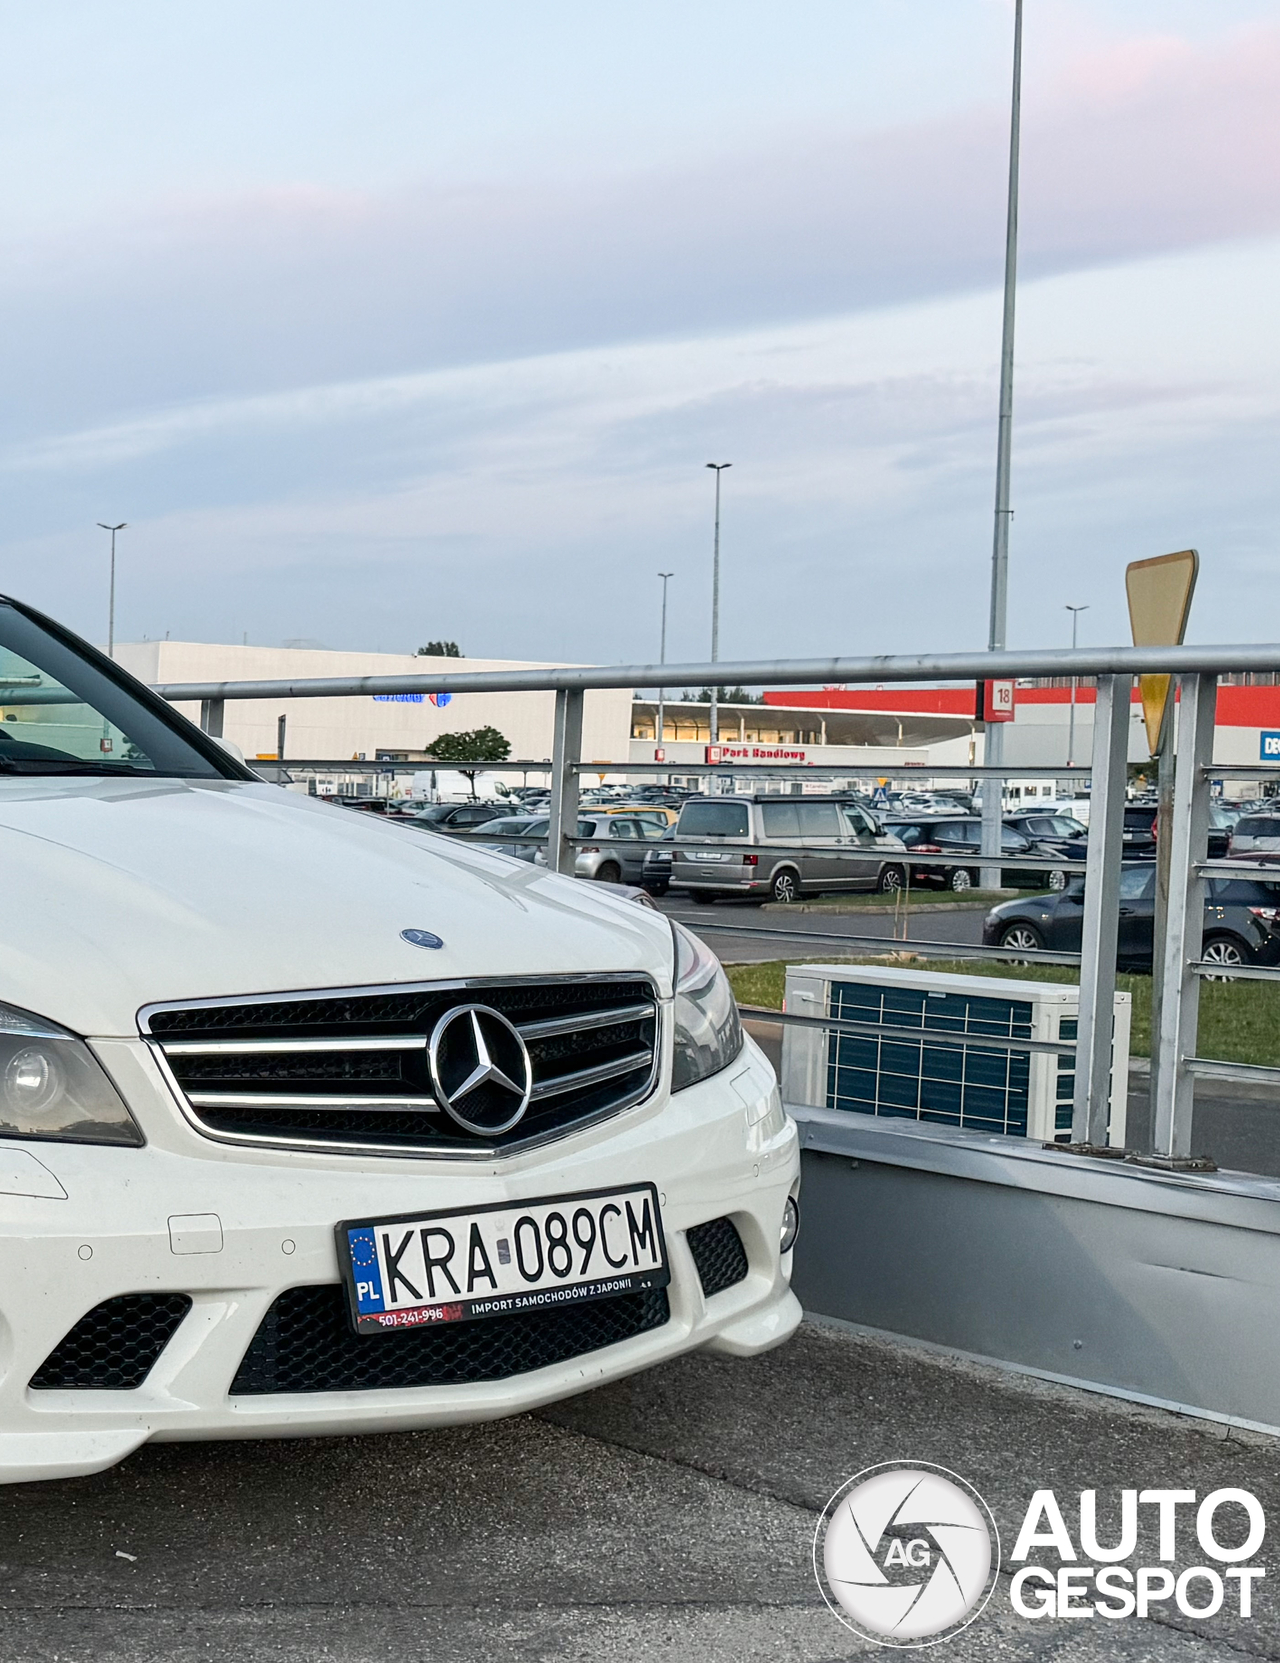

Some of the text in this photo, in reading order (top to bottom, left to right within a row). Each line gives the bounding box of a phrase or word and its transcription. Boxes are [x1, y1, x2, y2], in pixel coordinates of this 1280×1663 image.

[997, 688, 1010, 703] 18
[722, 747, 749, 757] Park
[752, 748, 806, 761] Handlowy
[382, 1198, 658, 1303] KRA 089CM
[356, 1281, 380, 1301] PL
[471, 1299, 512, 1315] IMPORT
[515, 1286, 588, 1308] SAMOCHODÓW
[589, 1285, 596, 1295] Z
[596, 1278, 632, 1294] JAPONII
[379, 1308, 443, 1327] 501-241-996
